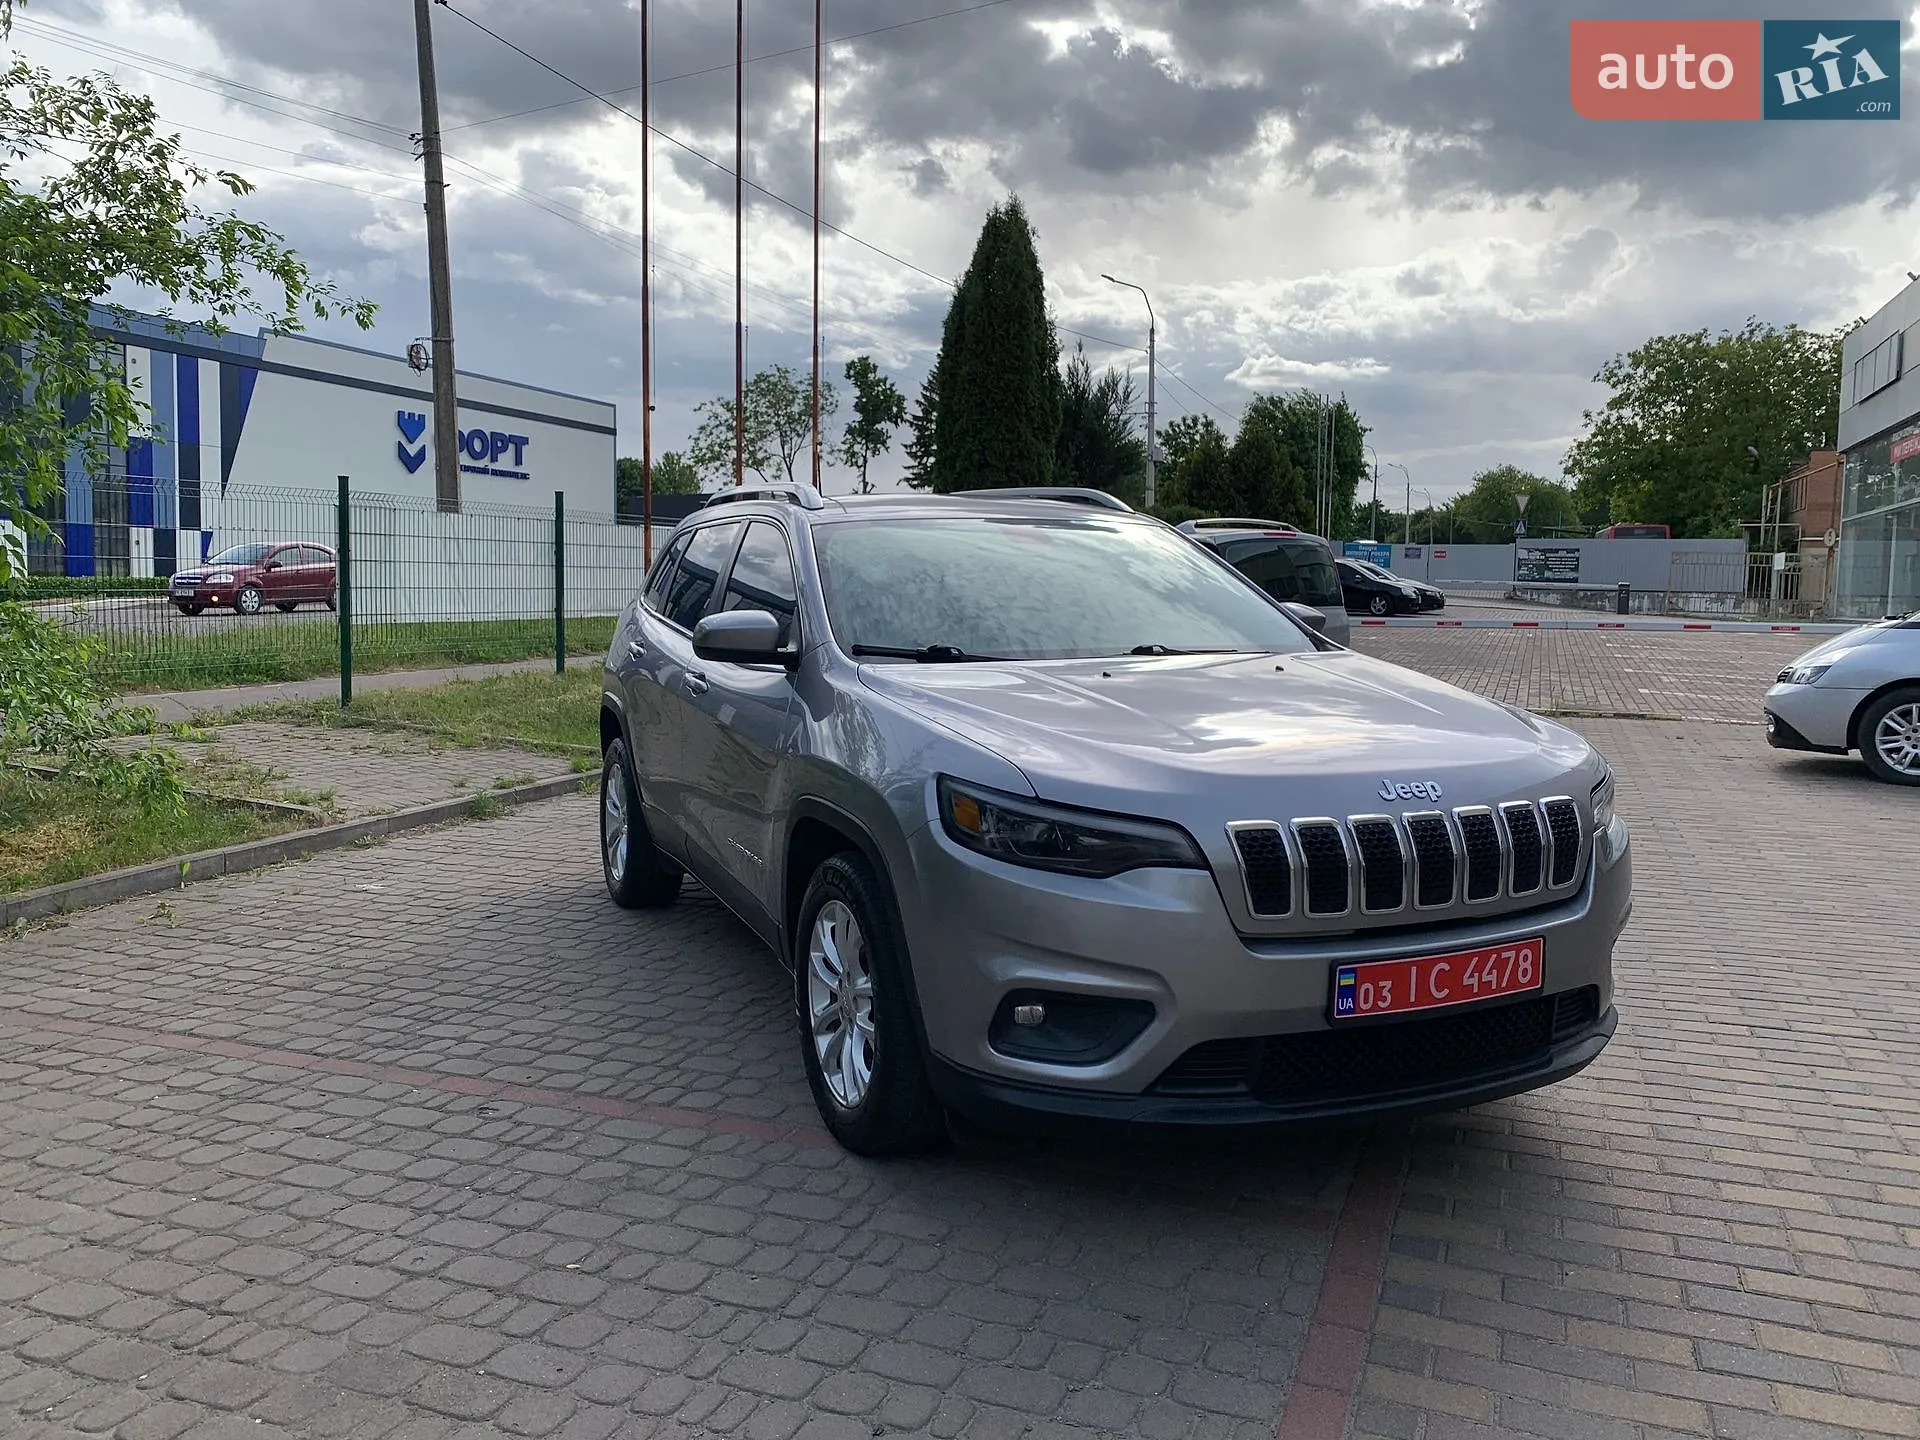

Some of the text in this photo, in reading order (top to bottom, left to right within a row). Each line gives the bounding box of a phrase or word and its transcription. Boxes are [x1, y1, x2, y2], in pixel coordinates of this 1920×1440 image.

[1378, 779, 1443, 802] Jeep
[1359, 980, 1393, 1010] 03
[1462, 948, 1533, 993] 4478
[1338, 997, 1354, 1010] UA
